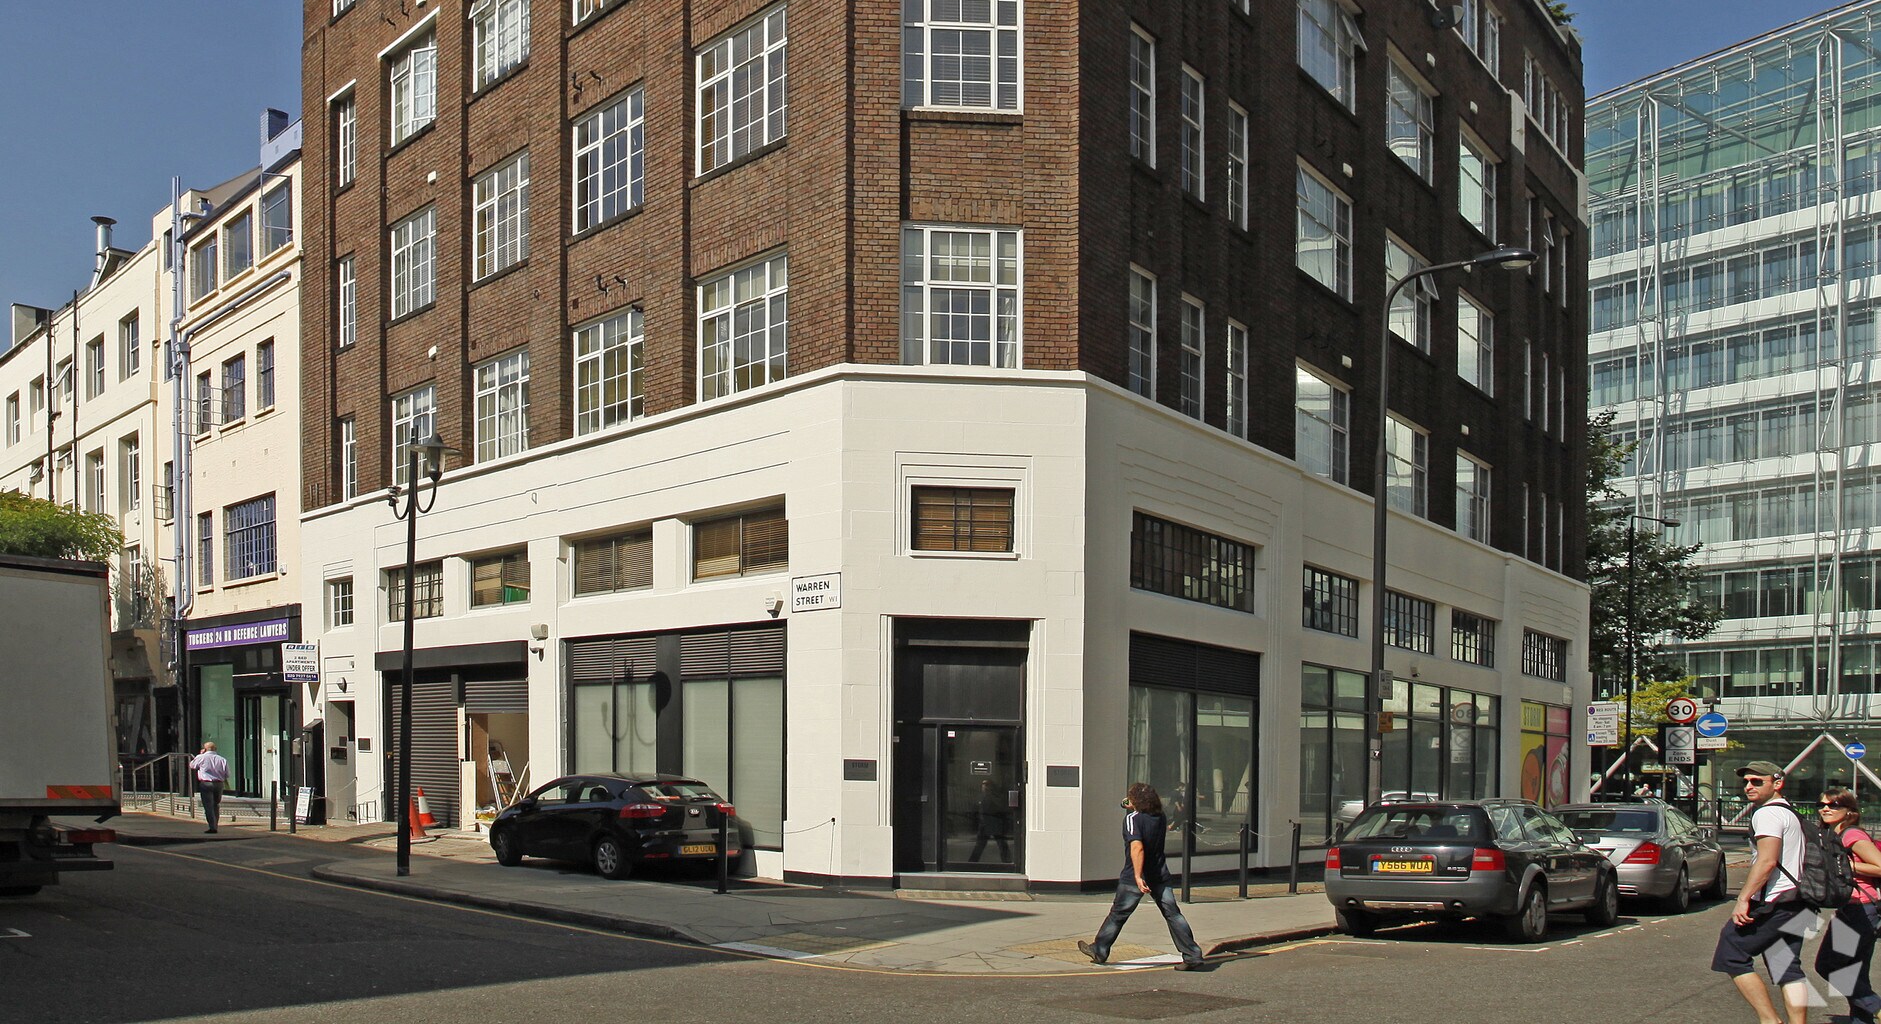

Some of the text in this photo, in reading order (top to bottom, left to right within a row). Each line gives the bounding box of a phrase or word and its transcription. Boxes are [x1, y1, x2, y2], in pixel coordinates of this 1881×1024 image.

[796, 581, 830, 592] WARREN
[796, 595, 824, 606] STREET
[188, 622, 287, 646] TUCKERS 24 HR DEFENCE LAWYERS
[1670, 705, 1693, 715] 30
[1381, 861, 1430, 870] Y566 WUA
